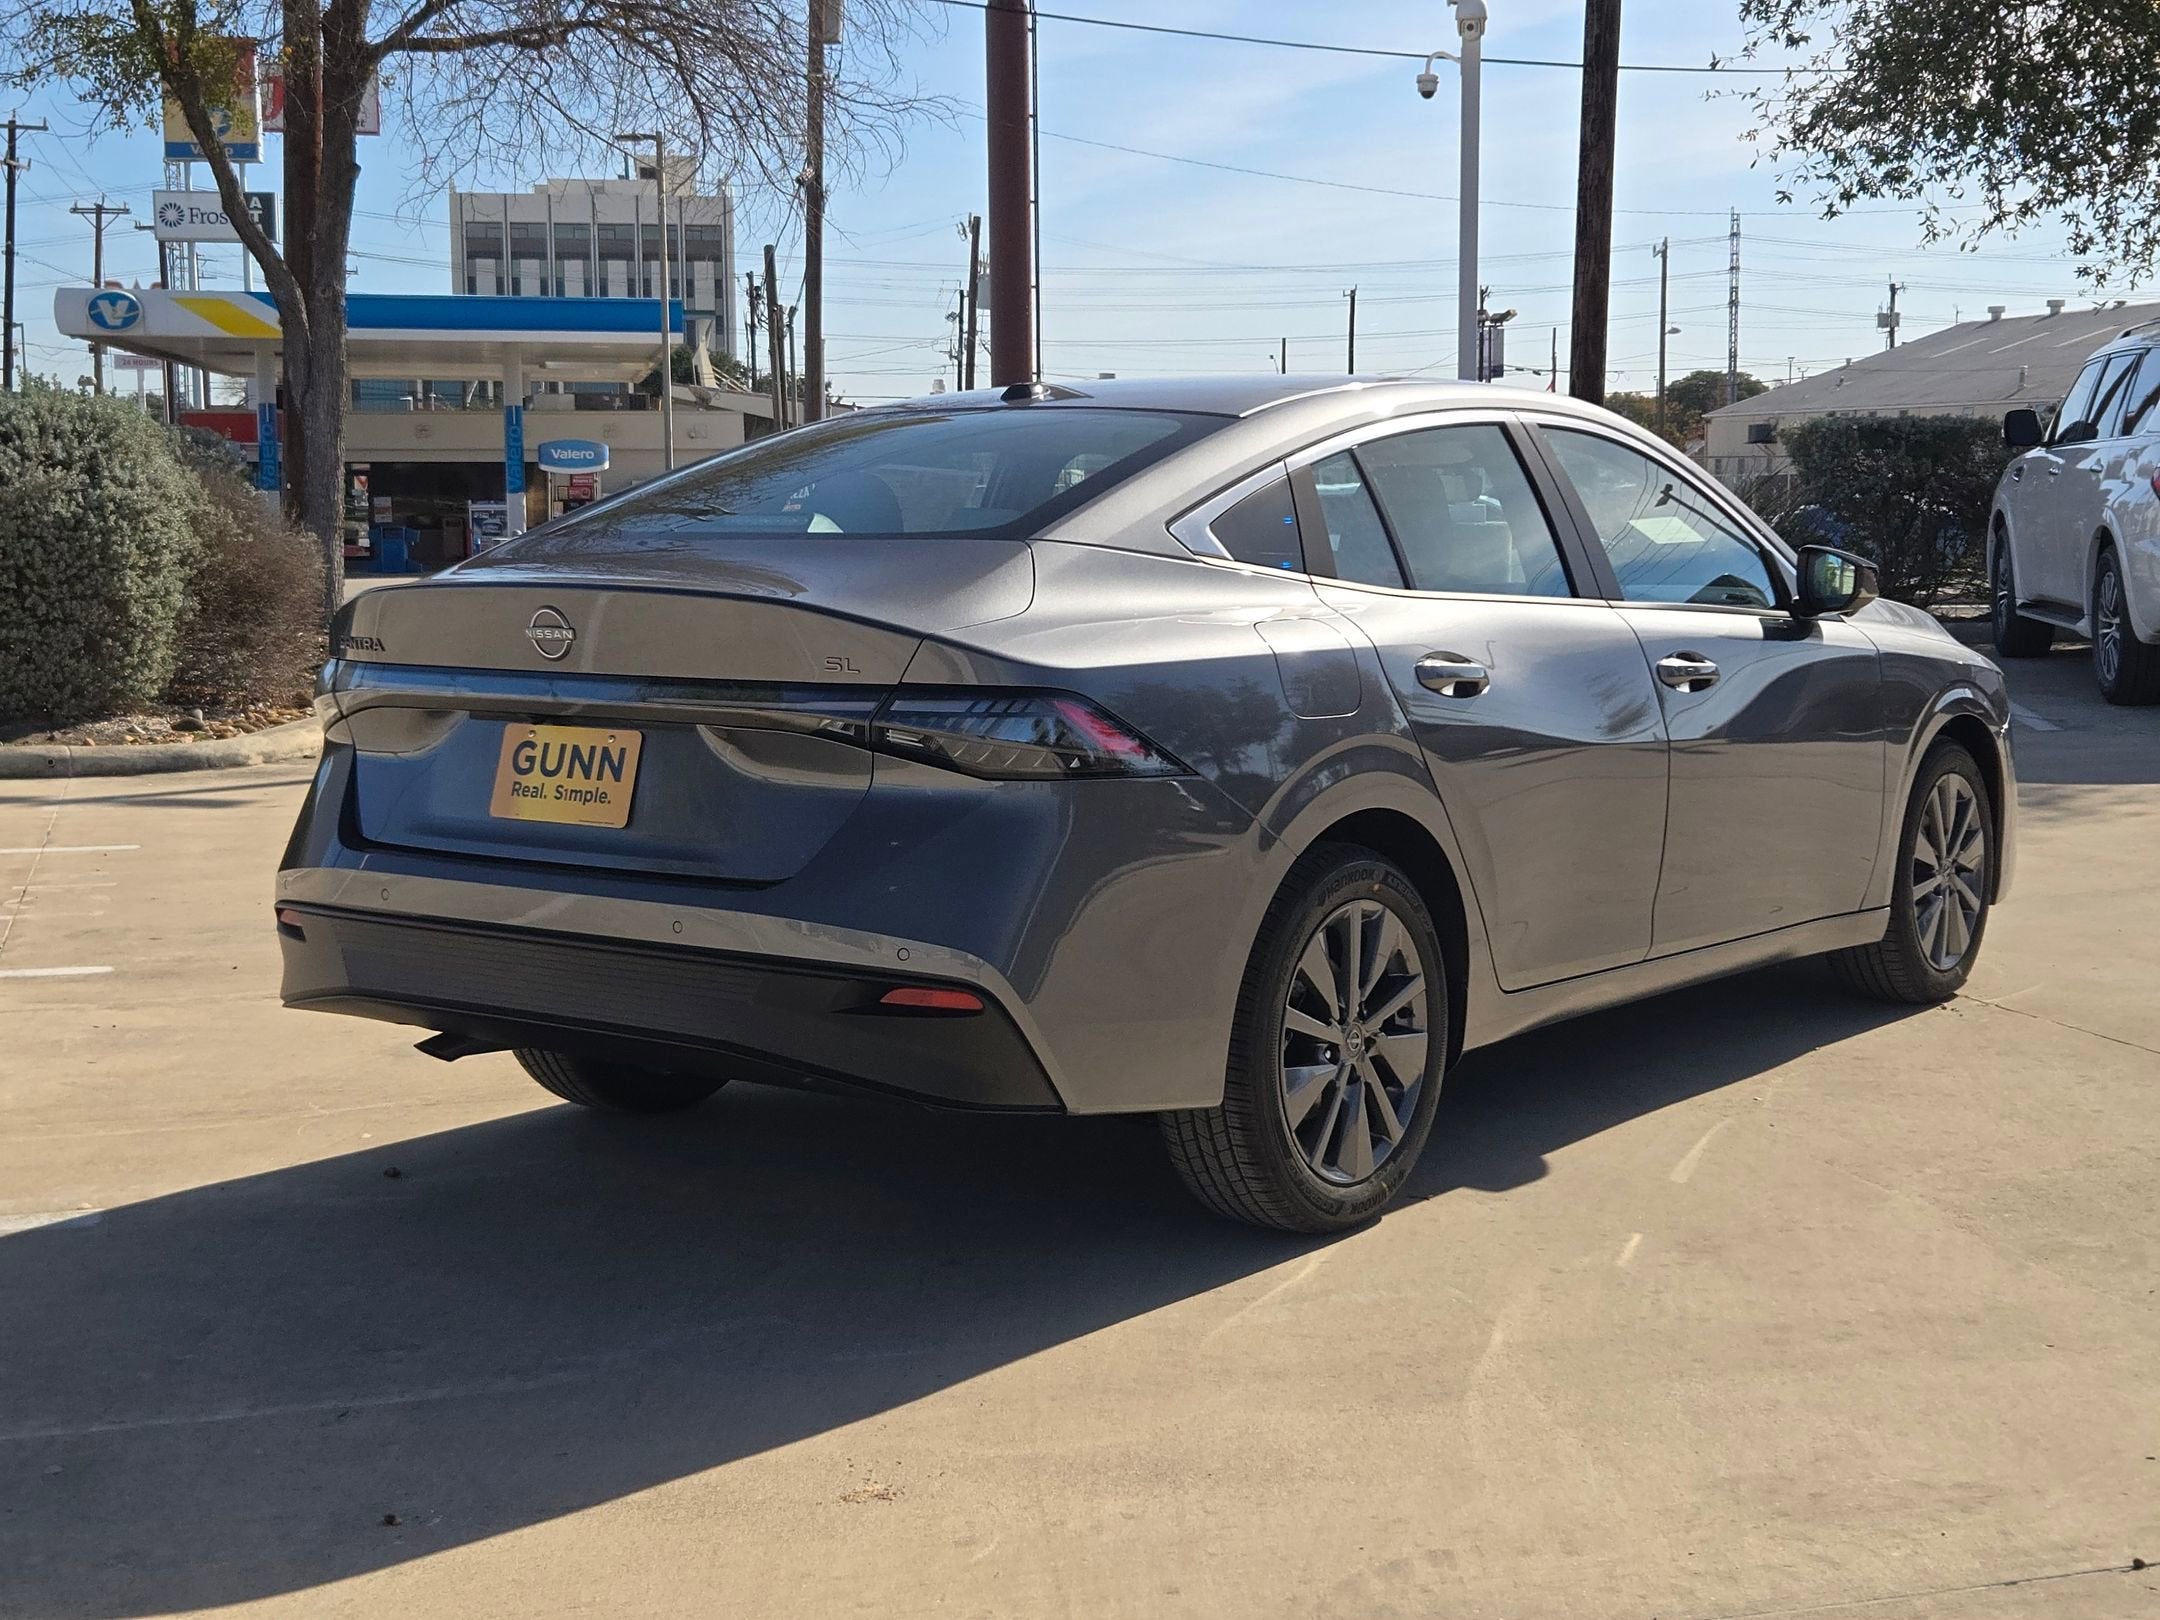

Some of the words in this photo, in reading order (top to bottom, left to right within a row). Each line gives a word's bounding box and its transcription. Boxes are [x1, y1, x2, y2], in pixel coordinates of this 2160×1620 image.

[188, 206, 229, 225] Fros
[509, 426, 523, 489] Valero
[552, 449, 595, 460] Valero
[526, 628, 574, 640] NISSAN
[824, 656, 861, 675] SL
[512, 740, 627, 783] GUNN
[511, 781, 548, 799] Real.
